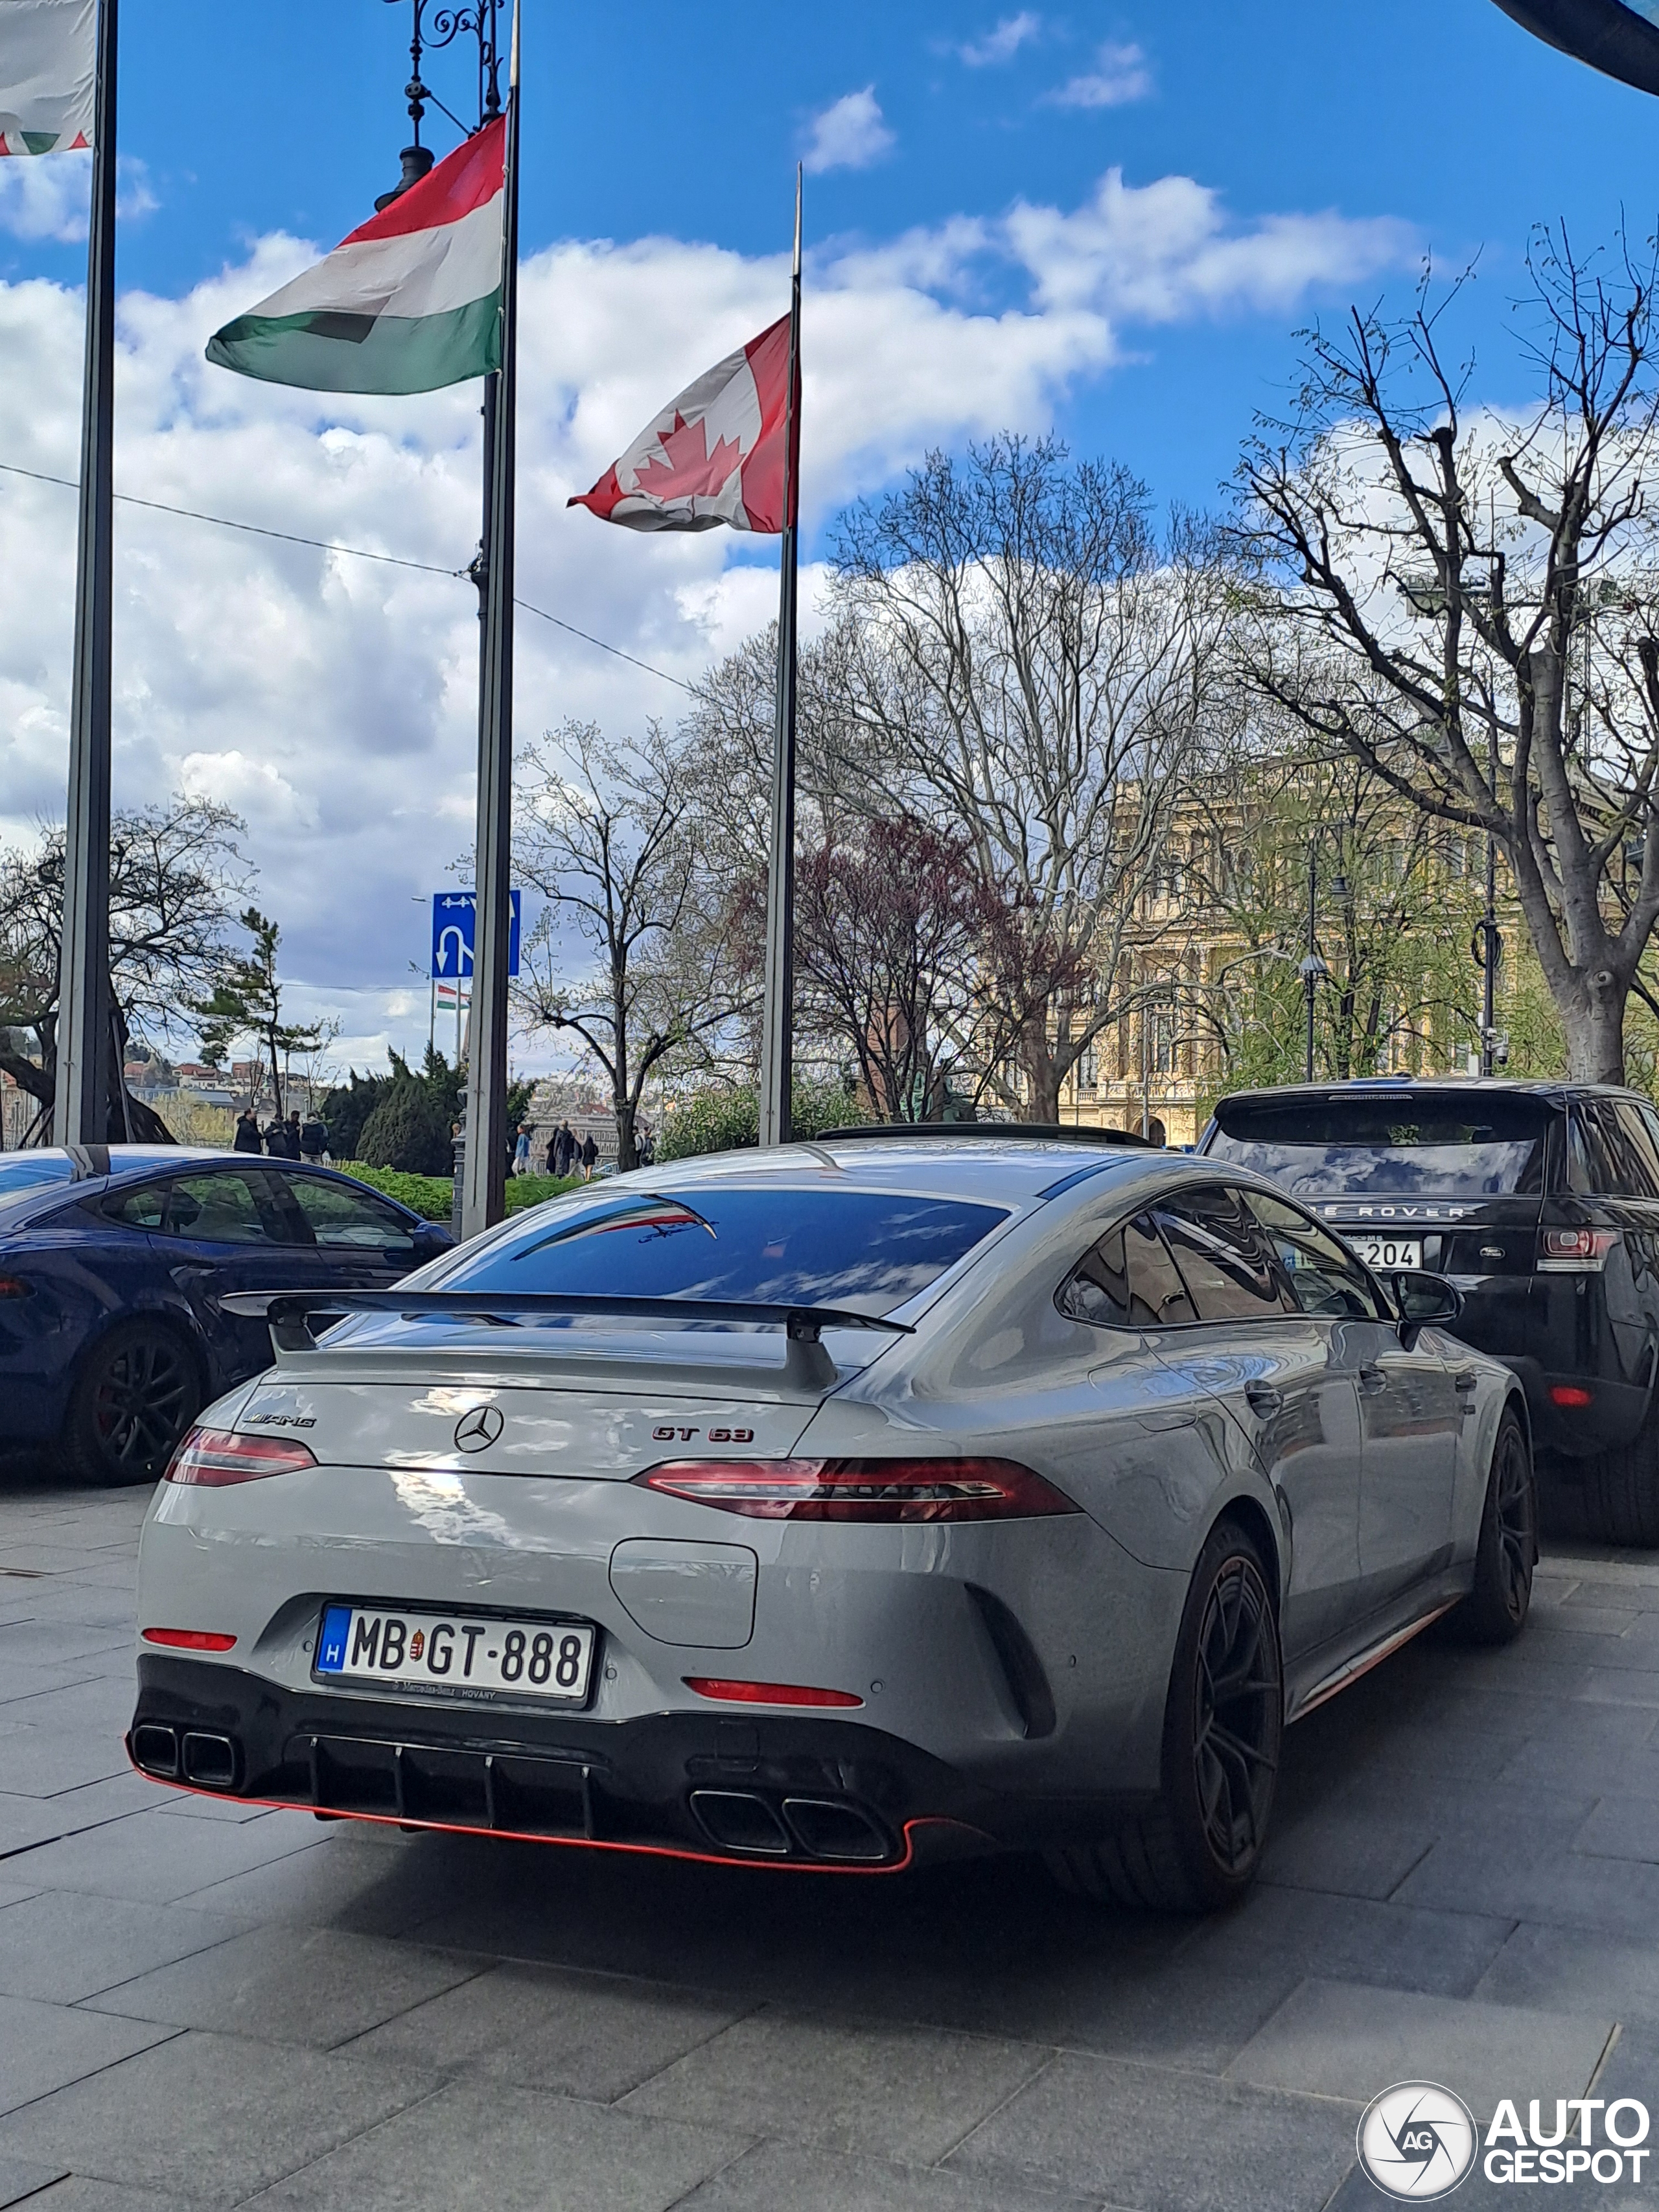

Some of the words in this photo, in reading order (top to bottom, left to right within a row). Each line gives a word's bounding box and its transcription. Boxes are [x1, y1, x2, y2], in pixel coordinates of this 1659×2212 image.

[1358, 1207, 1464, 1218] ROVER
[1350, 1243, 1413, 1266] -204
[261, 1413, 317, 1428] AMG
[652, 1426, 700, 1441] GT
[708, 1428, 754, 1443] 63
[326, 1644, 340, 1662] H
